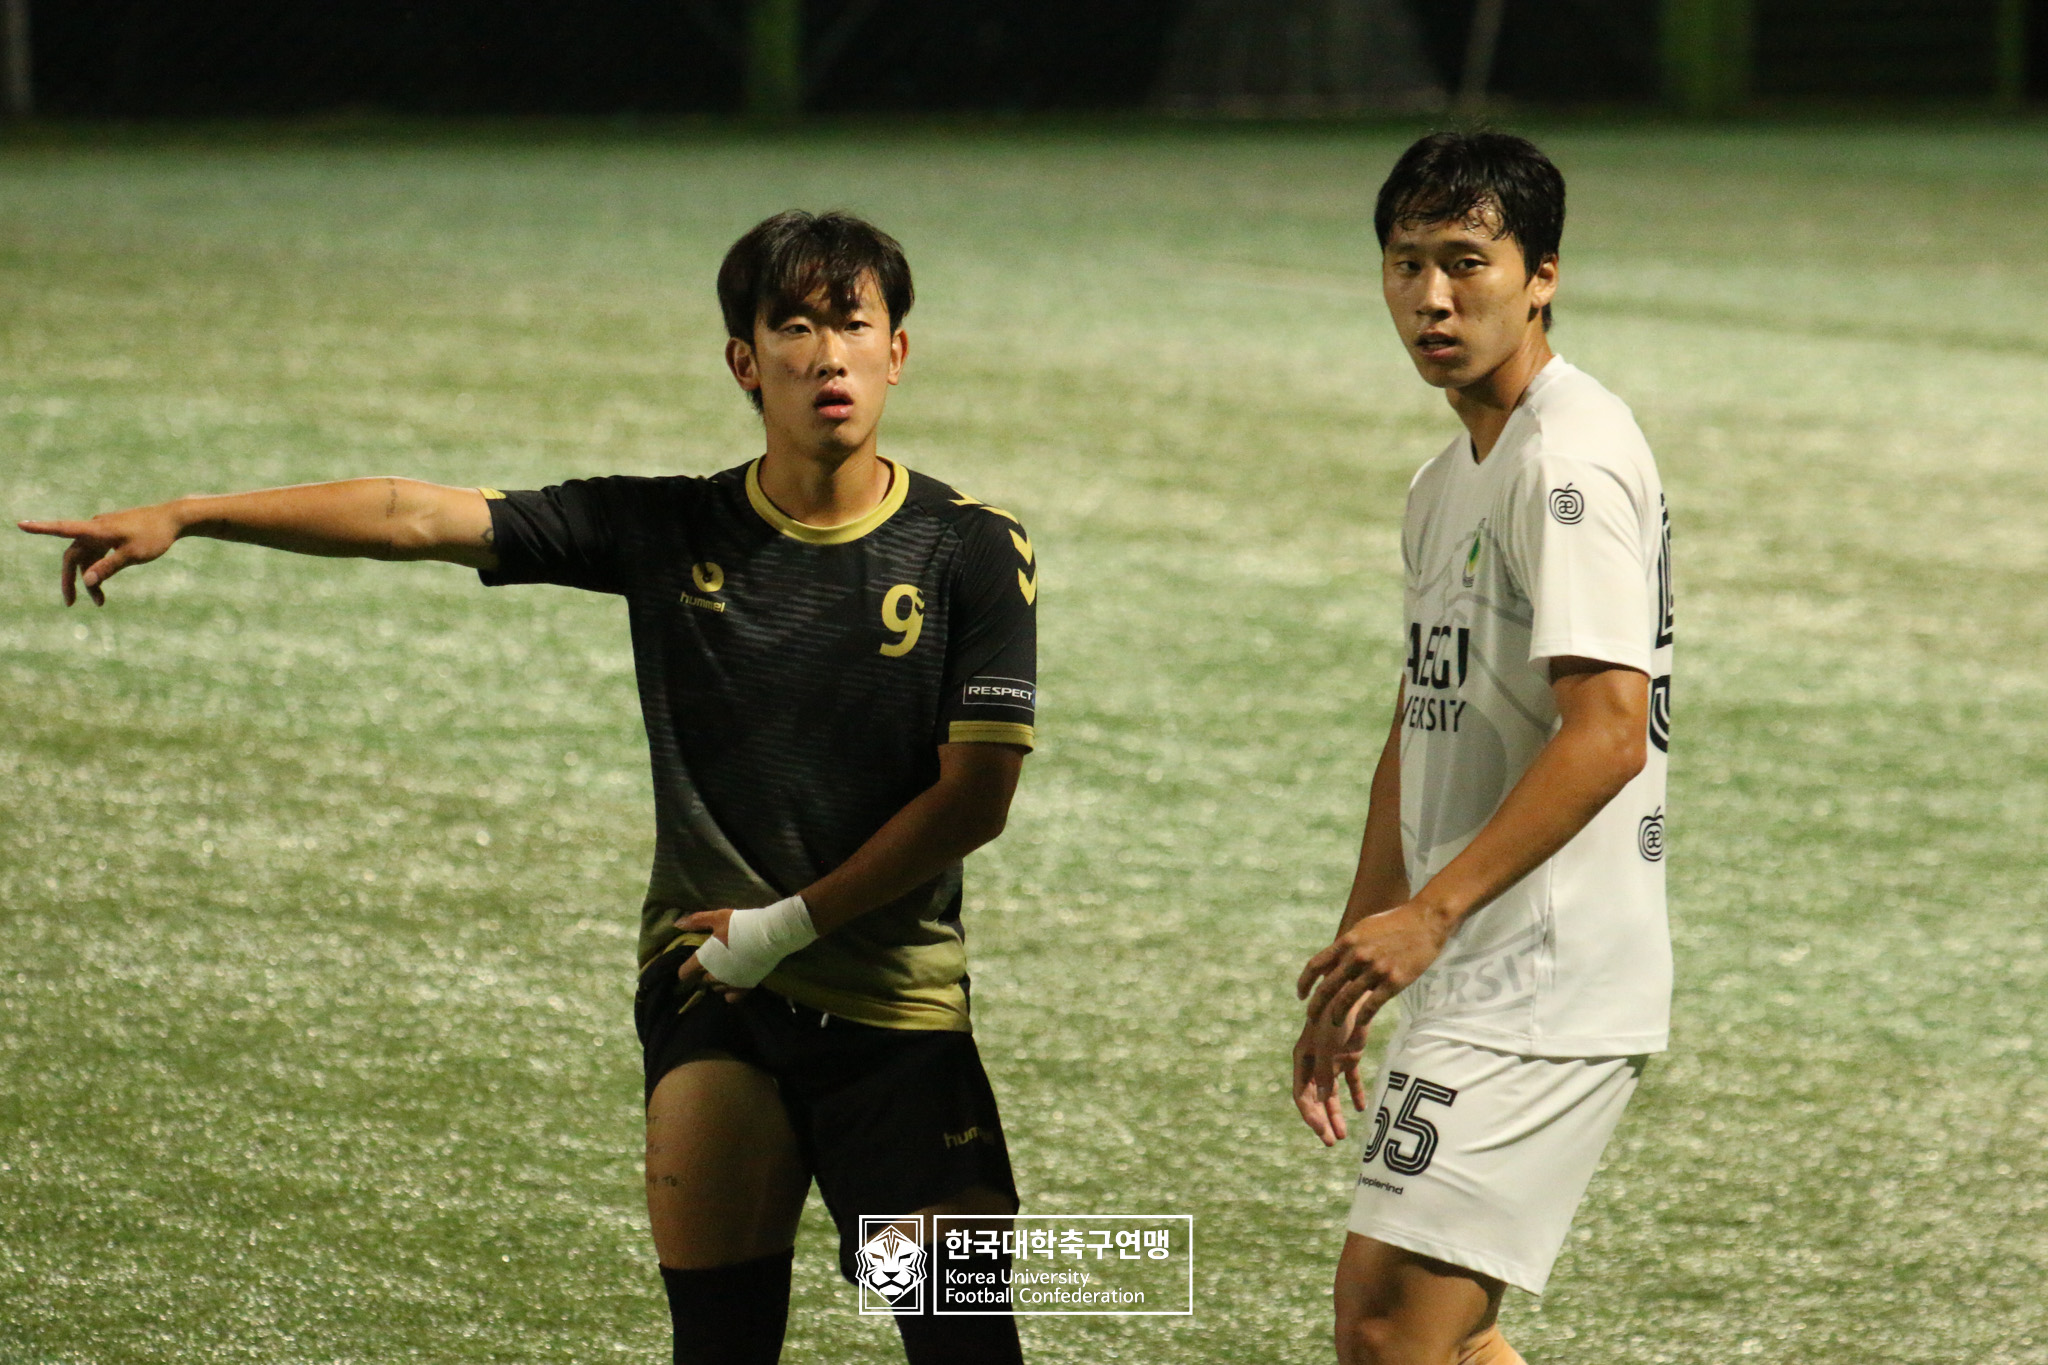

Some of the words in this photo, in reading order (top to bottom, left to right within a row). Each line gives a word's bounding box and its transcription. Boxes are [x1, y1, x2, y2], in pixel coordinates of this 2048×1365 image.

[680, 591, 726, 613] hummel
[879, 583, 926, 658] 9
[968, 686, 1033, 701] RESPECT
